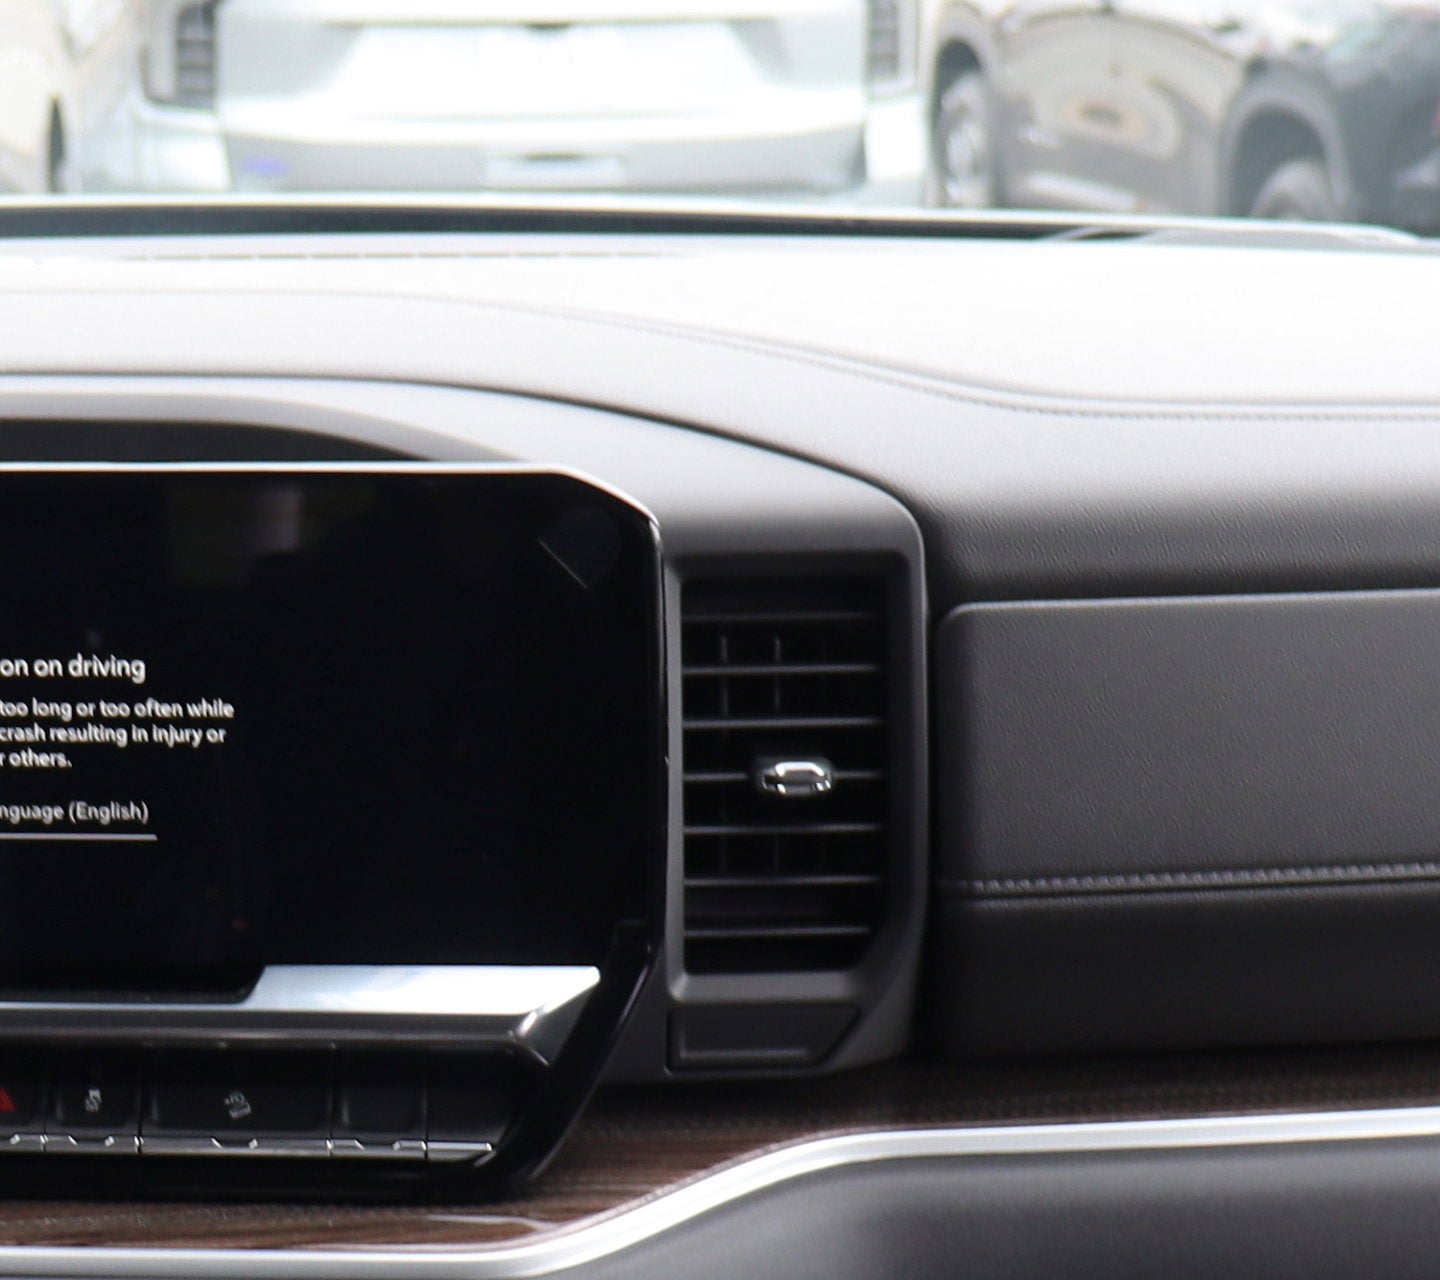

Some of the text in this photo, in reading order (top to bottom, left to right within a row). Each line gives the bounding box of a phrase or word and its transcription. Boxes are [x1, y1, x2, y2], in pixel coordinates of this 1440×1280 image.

[33, 658, 64, 677] on
[67, 652, 146, 683] driving
[32, 697, 73, 721] long
[75, 702, 97, 717] or
[99, 699, 131, 717] too
[133, 697, 184, 718] often
[186, 697, 235, 718] while
[49, 722, 128, 747] resulting
[131, 724, 149, 743] in
[152, 724, 203, 748] injury
[205, 728, 227, 743] or
[8, 747, 73, 768] others.
[68, 801, 149, 825] (English)
